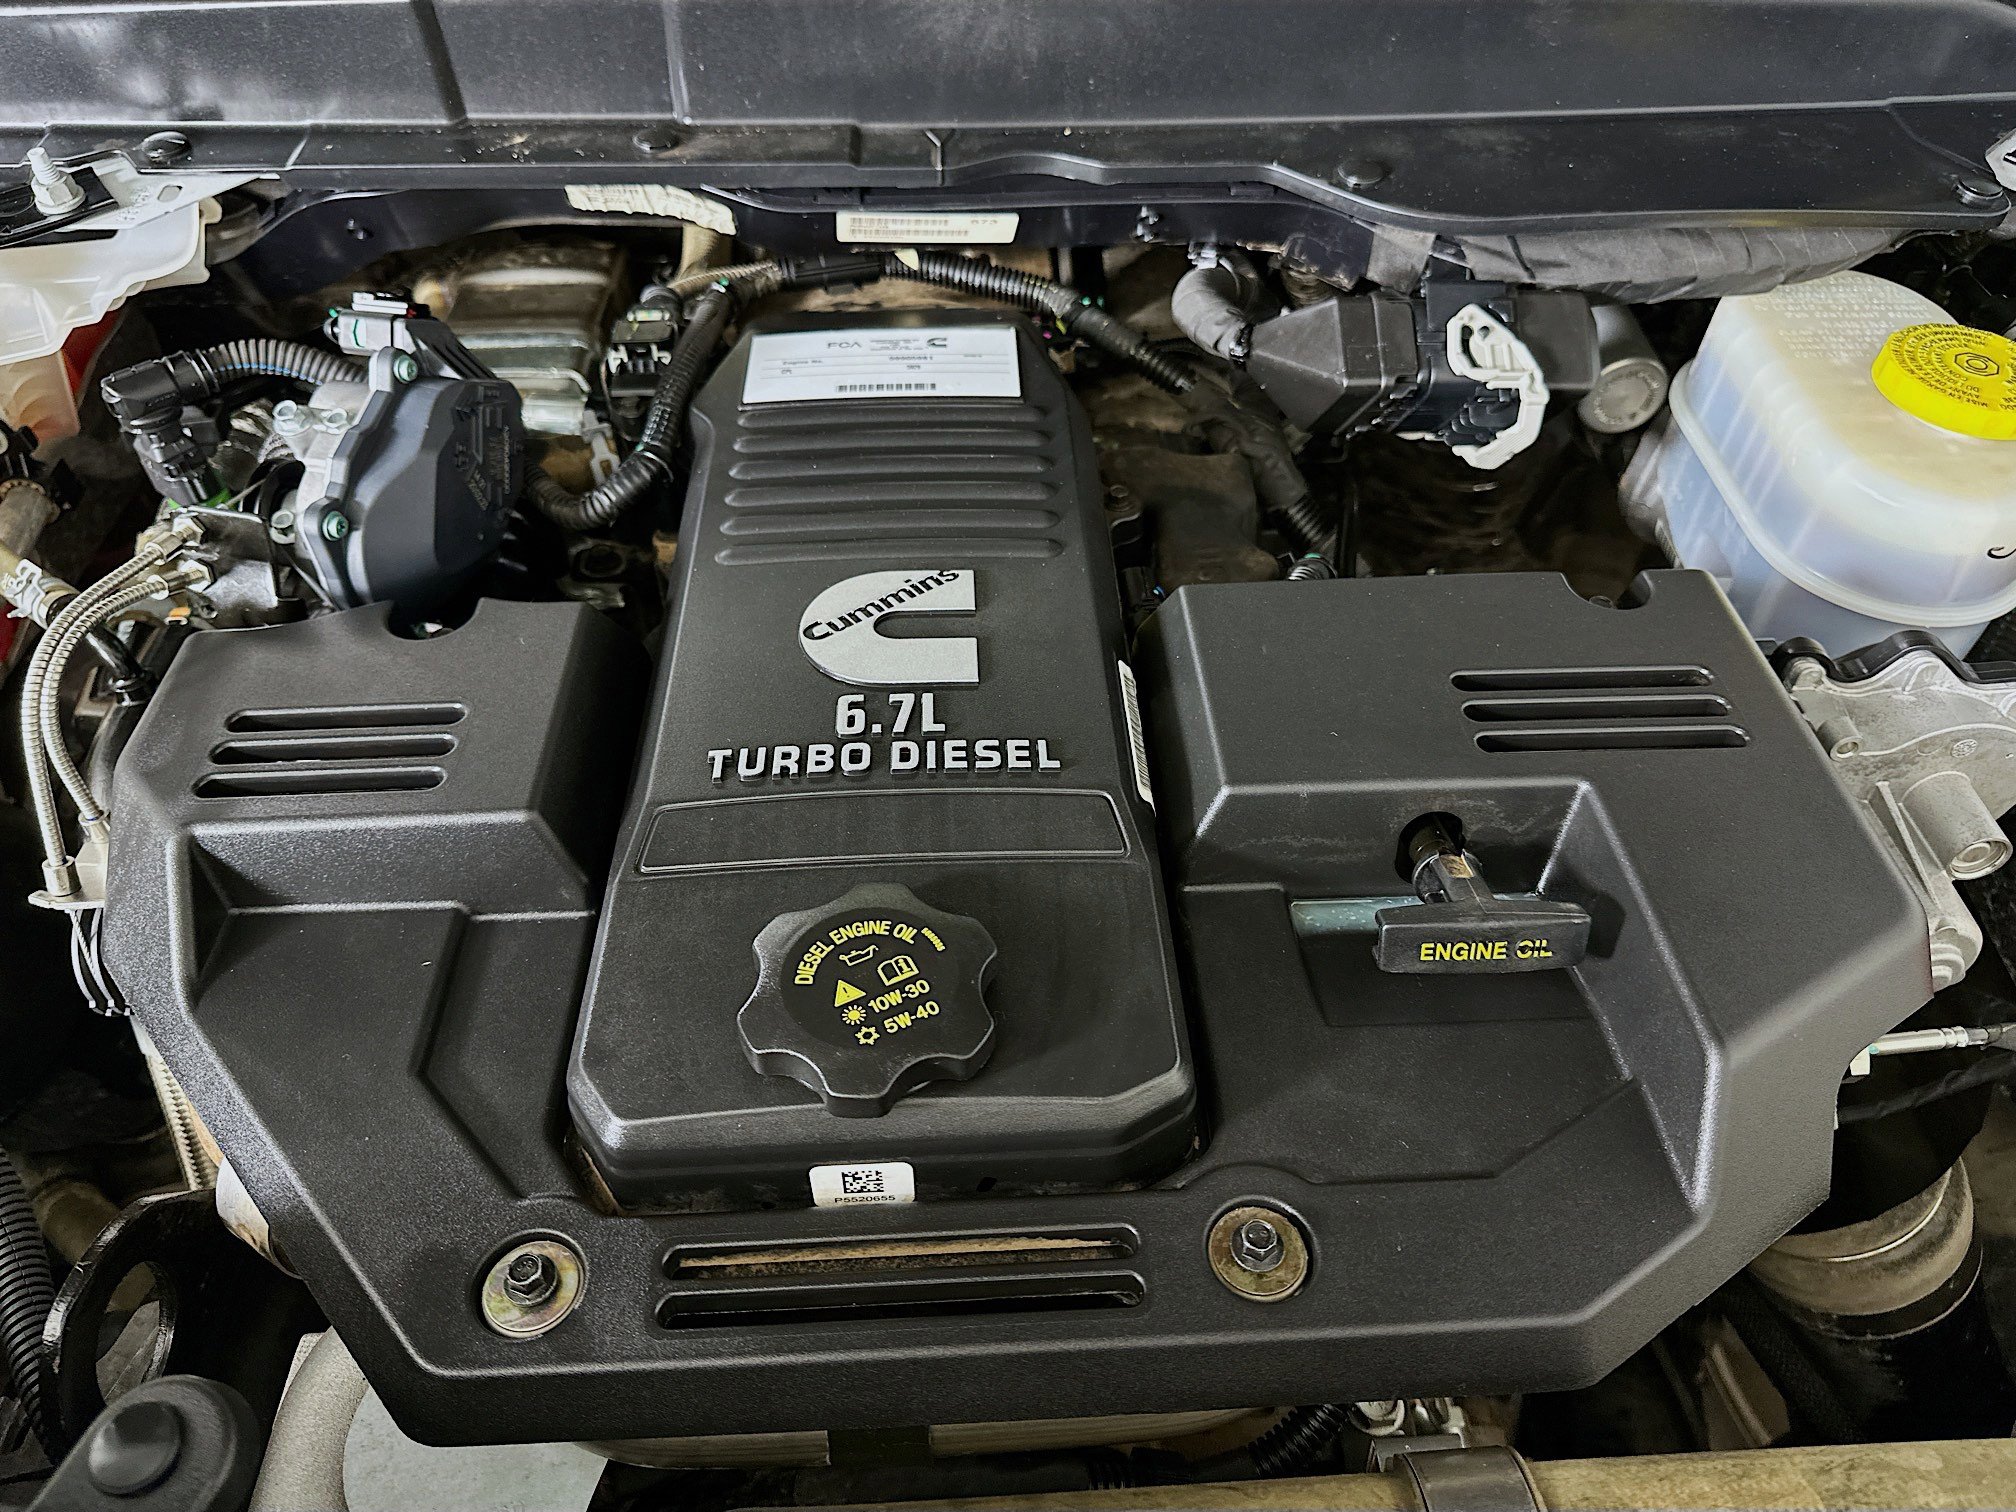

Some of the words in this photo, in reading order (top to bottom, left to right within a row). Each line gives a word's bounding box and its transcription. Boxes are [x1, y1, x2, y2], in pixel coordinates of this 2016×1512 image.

[802, 570, 960, 641] Cummins
[836, 692, 946, 738] 6.7L
[707, 742, 871, 784] TURBO
[890, 739, 1061, 775] DIESEL
[794, 941, 834, 985] DIESEL
[829, 920, 892, 945] ENGINE
[893, 923, 920, 944] OIL
[1419, 940, 1508, 961] ENGINE
[1516, 939, 1553, 959] OIL
[868, 979, 930, 1013] 10W-30
[884, 1001, 940, 1034] 5W-40
[834, 1195, 896, 1204] P5520655
